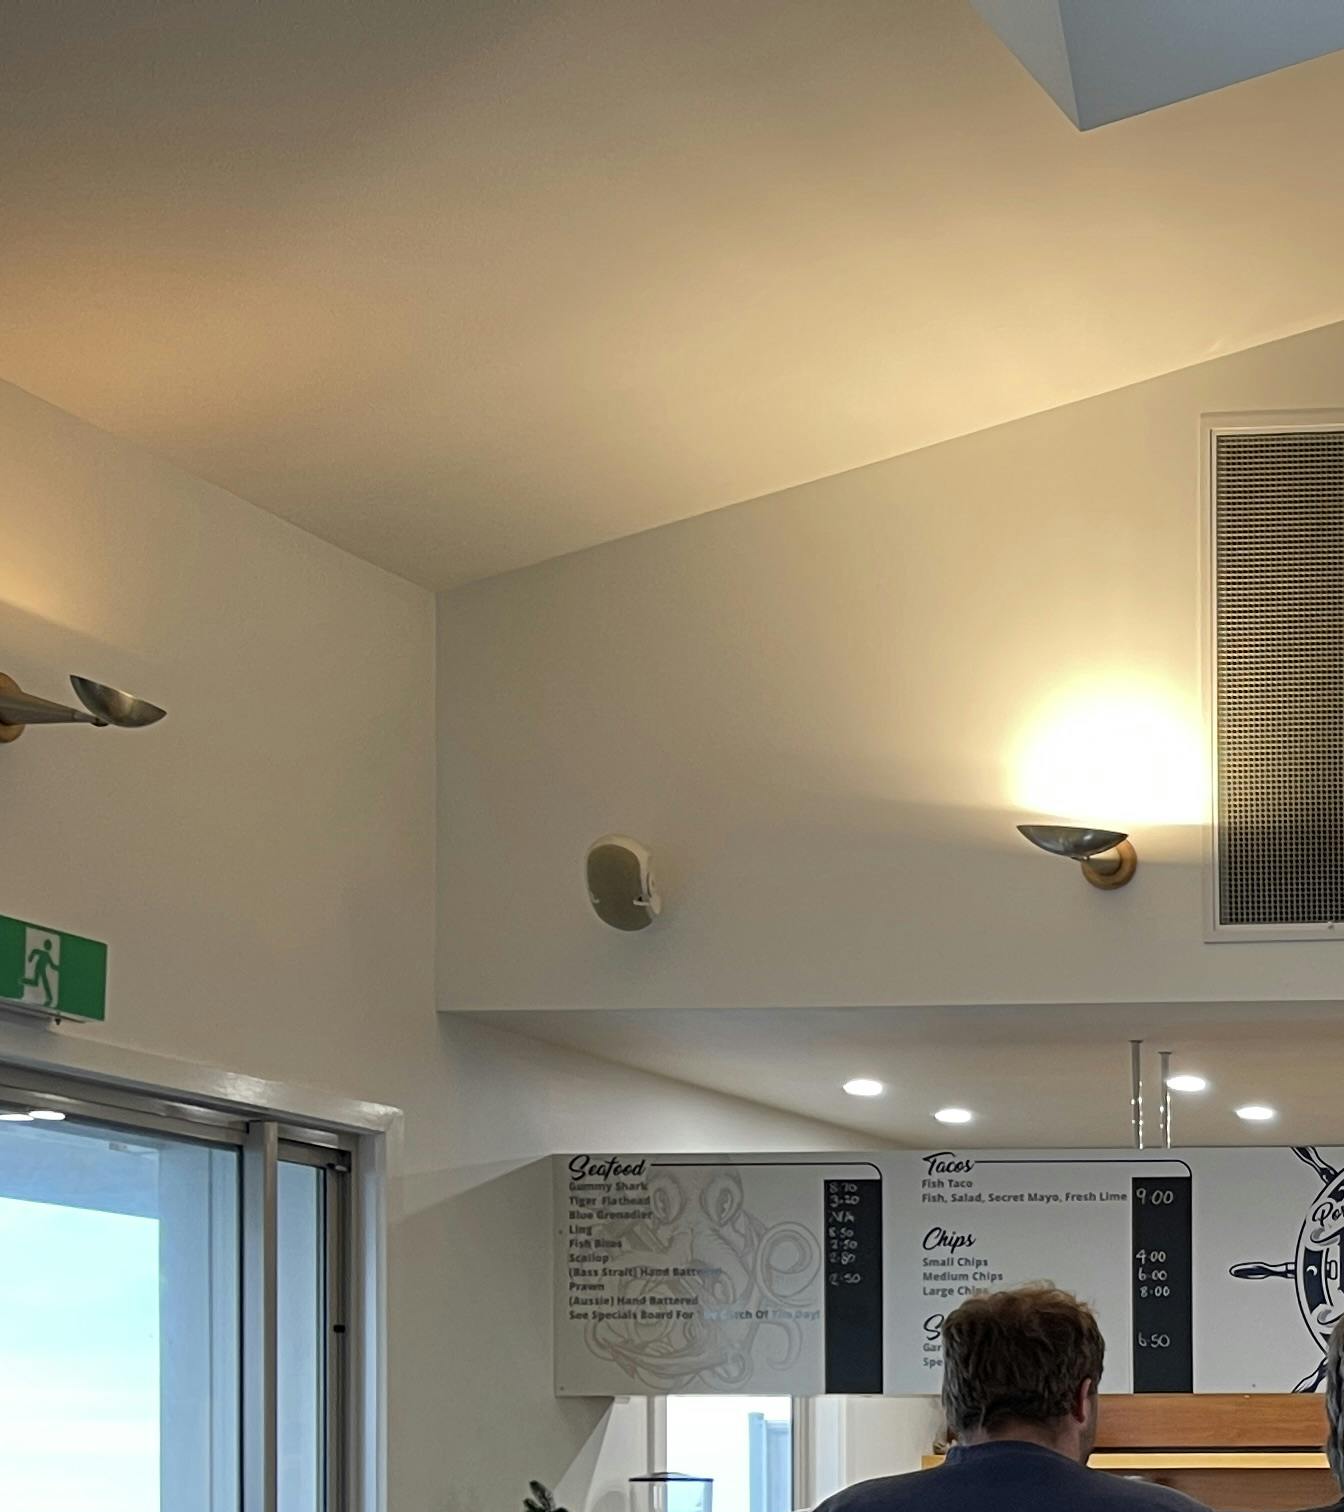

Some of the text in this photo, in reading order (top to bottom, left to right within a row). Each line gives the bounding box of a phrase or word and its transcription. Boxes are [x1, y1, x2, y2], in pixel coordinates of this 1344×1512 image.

[568, 1154, 647, 1181] Seafood
[922, 1151, 975, 1176] Tacos
[569, 1182, 648, 1193] Gummy Shark
[922, 1179, 973, 1188] Fish Taco
[569, 1196, 597, 1207] Tiger
[922, 1192, 1127, 1204] Fish, Salad, Secret Mayo, Fresh Lime
[569, 1210, 653, 1219] Blue Grenadier
[569, 1225, 592, 1236] Ling
[569, 1239, 591, 1249] Fish
[922, 1227, 977, 1254] Chips
[569, 1253, 609, 1264] Scallop
[922, 1257, 988, 1268] Small Chips
[569, 1268, 598, 1278] (Bass
[640, 1267, 669, 1276] Hand
[922, 1272, 1003, 1283] Medium Chips
[569, 1282, 604, 1291] Prawn
[922, 1286, 954, 1298] Large
[569, 1296, 698, 1306] (Aussie) Hand Battered
[569, 1310, 588, 1320] See
[591, 1310, 637, 1322] Specials
[641, 1310, 673, 1320] Board
[676, 1310, 693, 1320] For
[755, 1310, 768, 1320] Of
